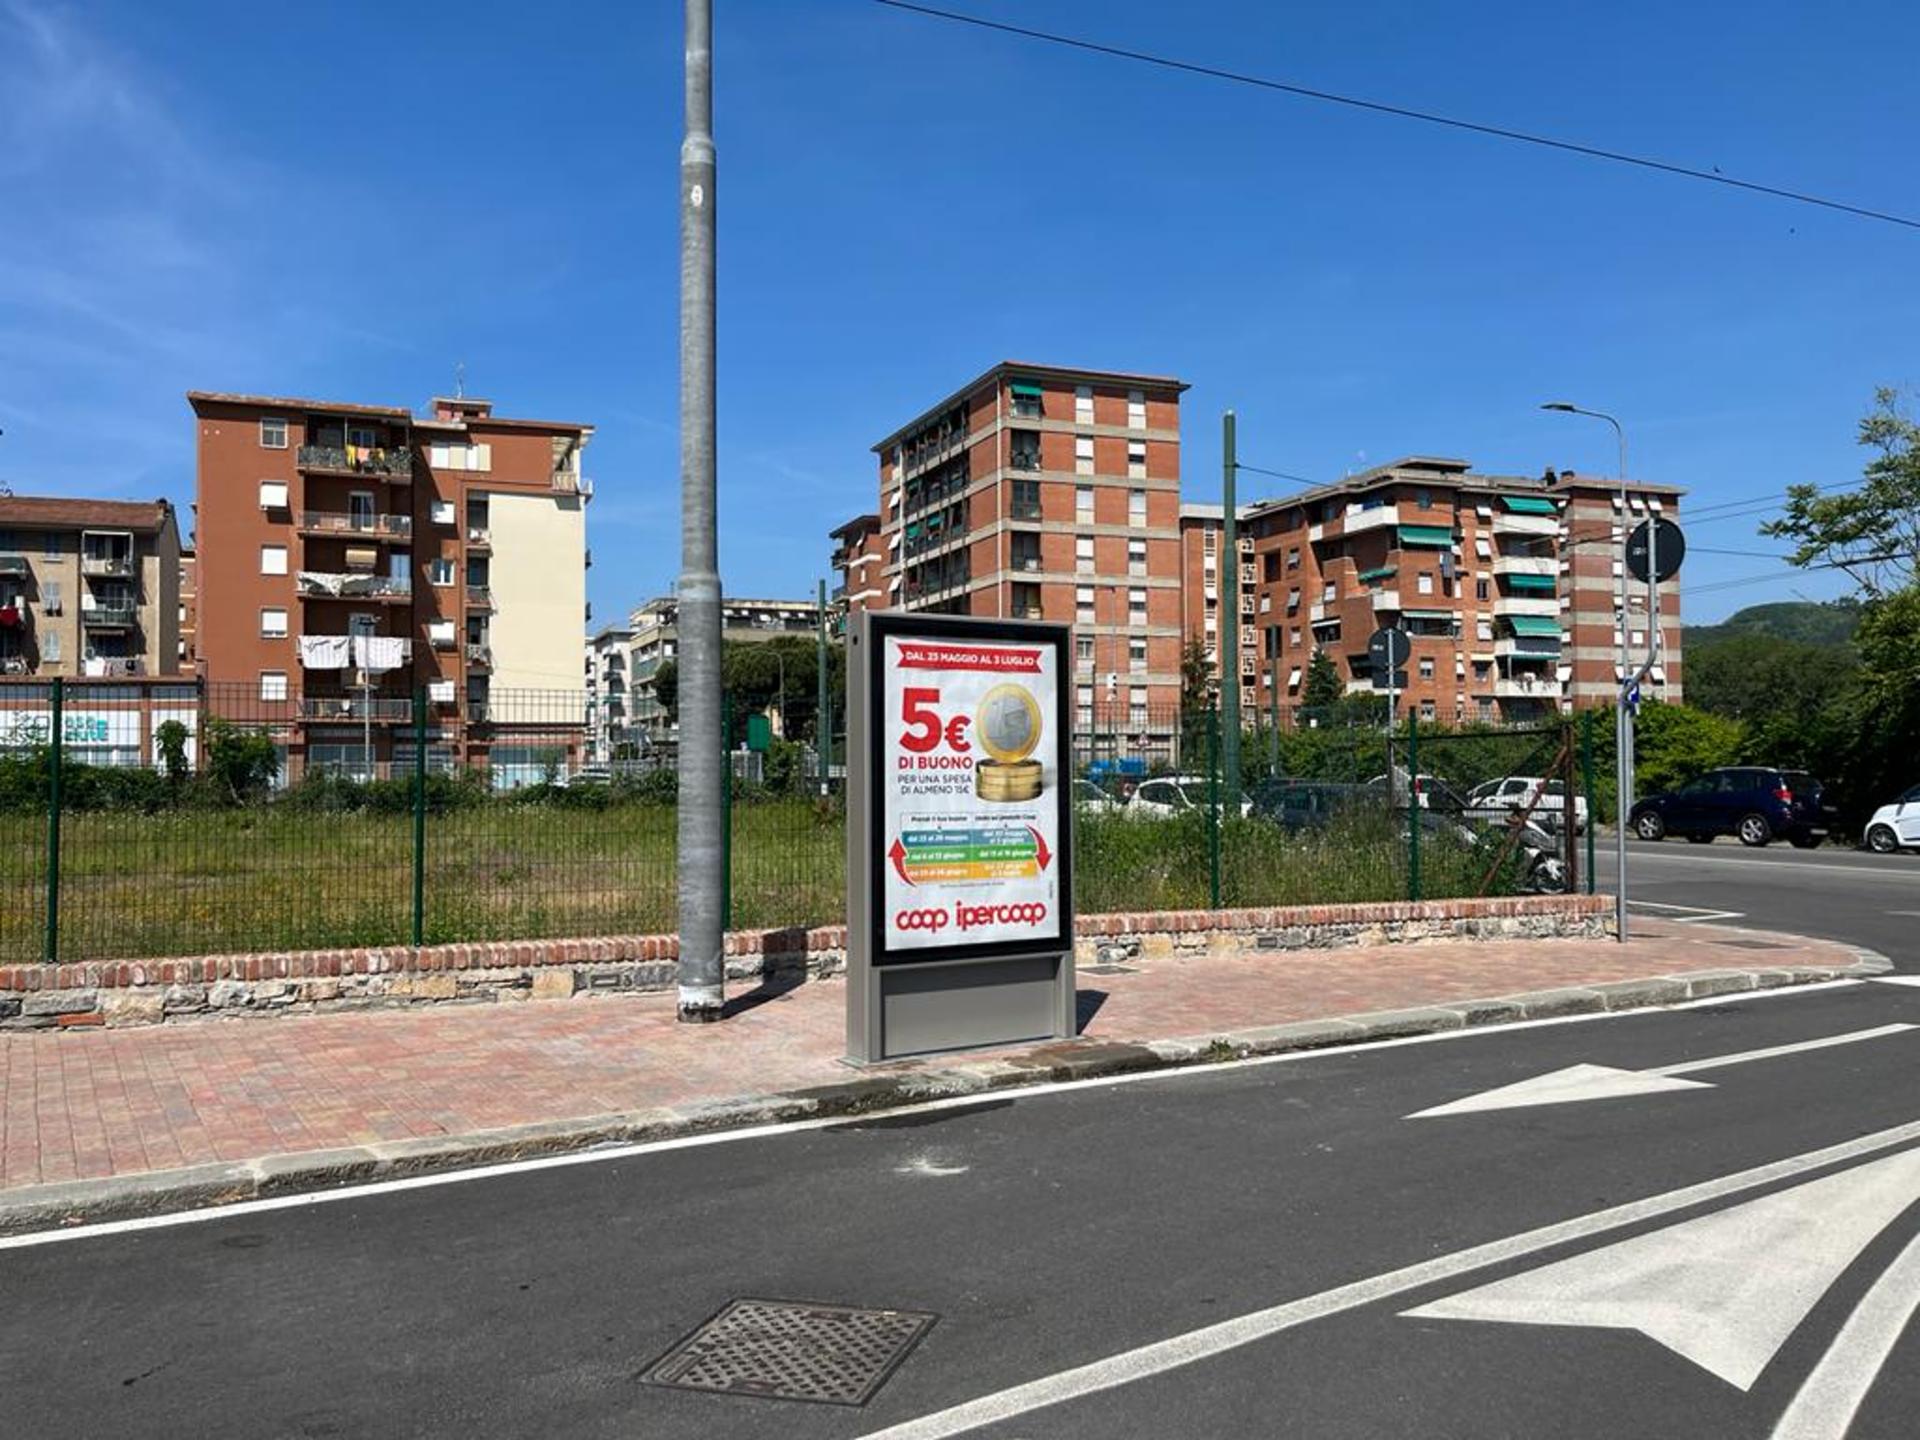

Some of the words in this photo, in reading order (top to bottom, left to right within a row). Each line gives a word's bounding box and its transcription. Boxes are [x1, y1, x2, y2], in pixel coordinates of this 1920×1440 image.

[905, 651, 926, 661] DAL
[941, 653, 978, 664] MAGGIO
[980, 655, 992, 664] AL
[1002, 656, 1035, 666] LUGLIO
[898, 757, 914, 769] DI
[918, 756, 973, 769] BUONO
[897, 775, 918, 784] PER
[919, 774, 940, 784] UNA
[943, 774, 972, 784] SPESA
[901, 786, 913, 796] DI
[914, 785, 954, 795] ALMENO
[896, 908, 949, 933] coop
[956, 900, 1047, 932] ipercoop
